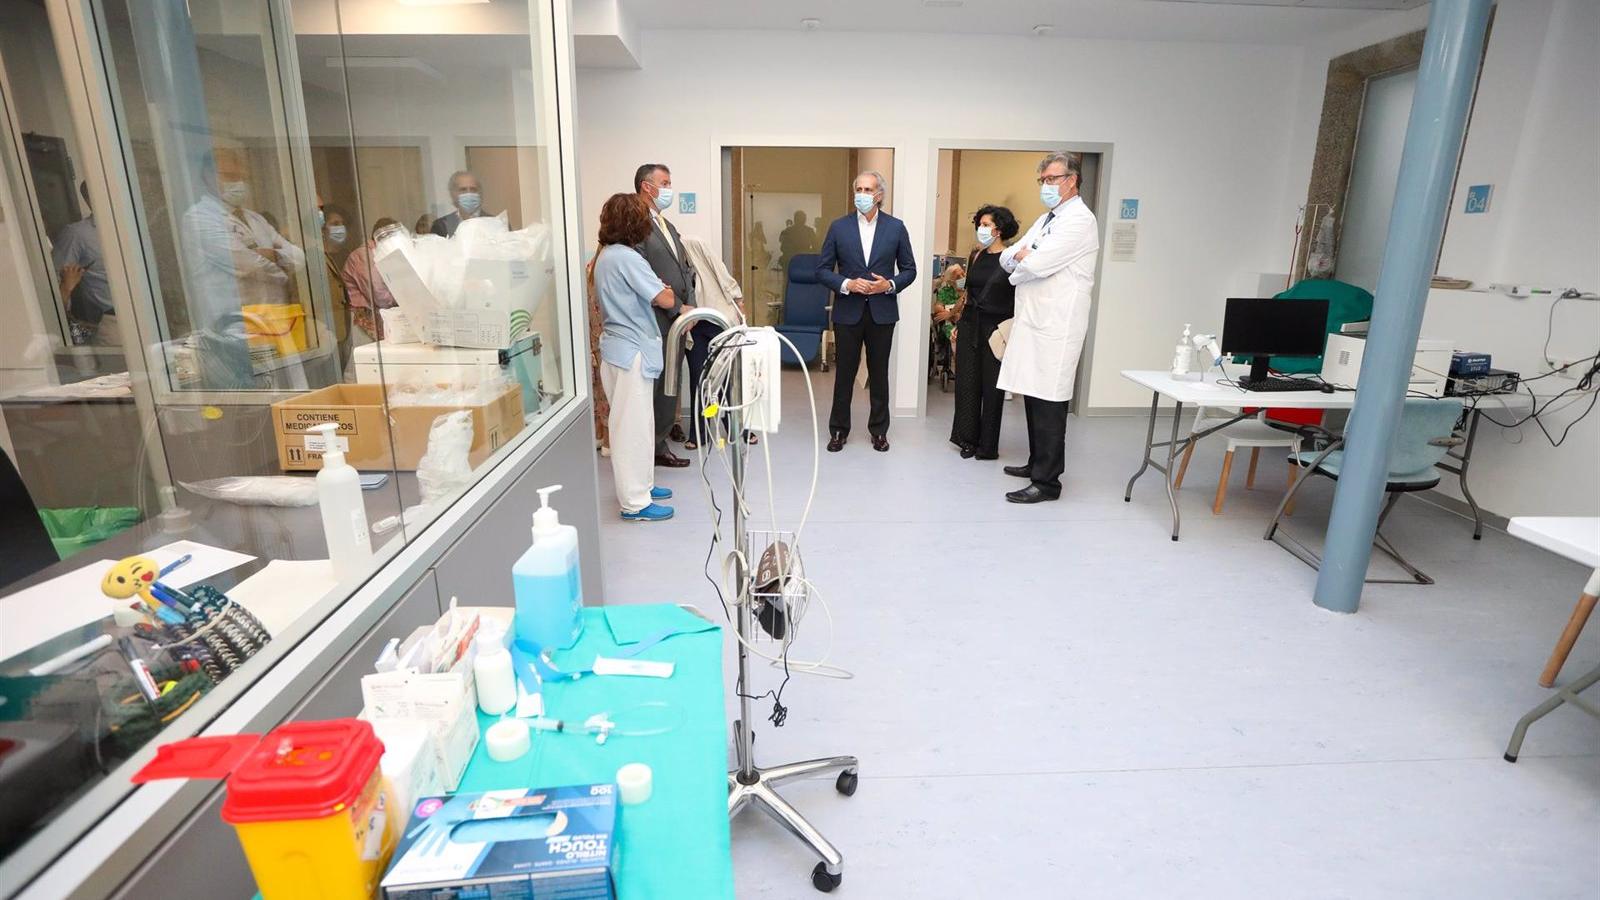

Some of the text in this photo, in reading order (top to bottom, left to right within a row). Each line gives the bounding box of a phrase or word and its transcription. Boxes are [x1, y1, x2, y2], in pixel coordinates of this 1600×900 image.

[681, 201, 695, 212] 02
[1467, 198, 1485, 211] 04
[1122, 207, 1136, 218] 03
[296, 413, 340, 422] CONTIENE
[548, 839, 607, 855] TOUCH
[565, 849, 607, 860] NITRILO
